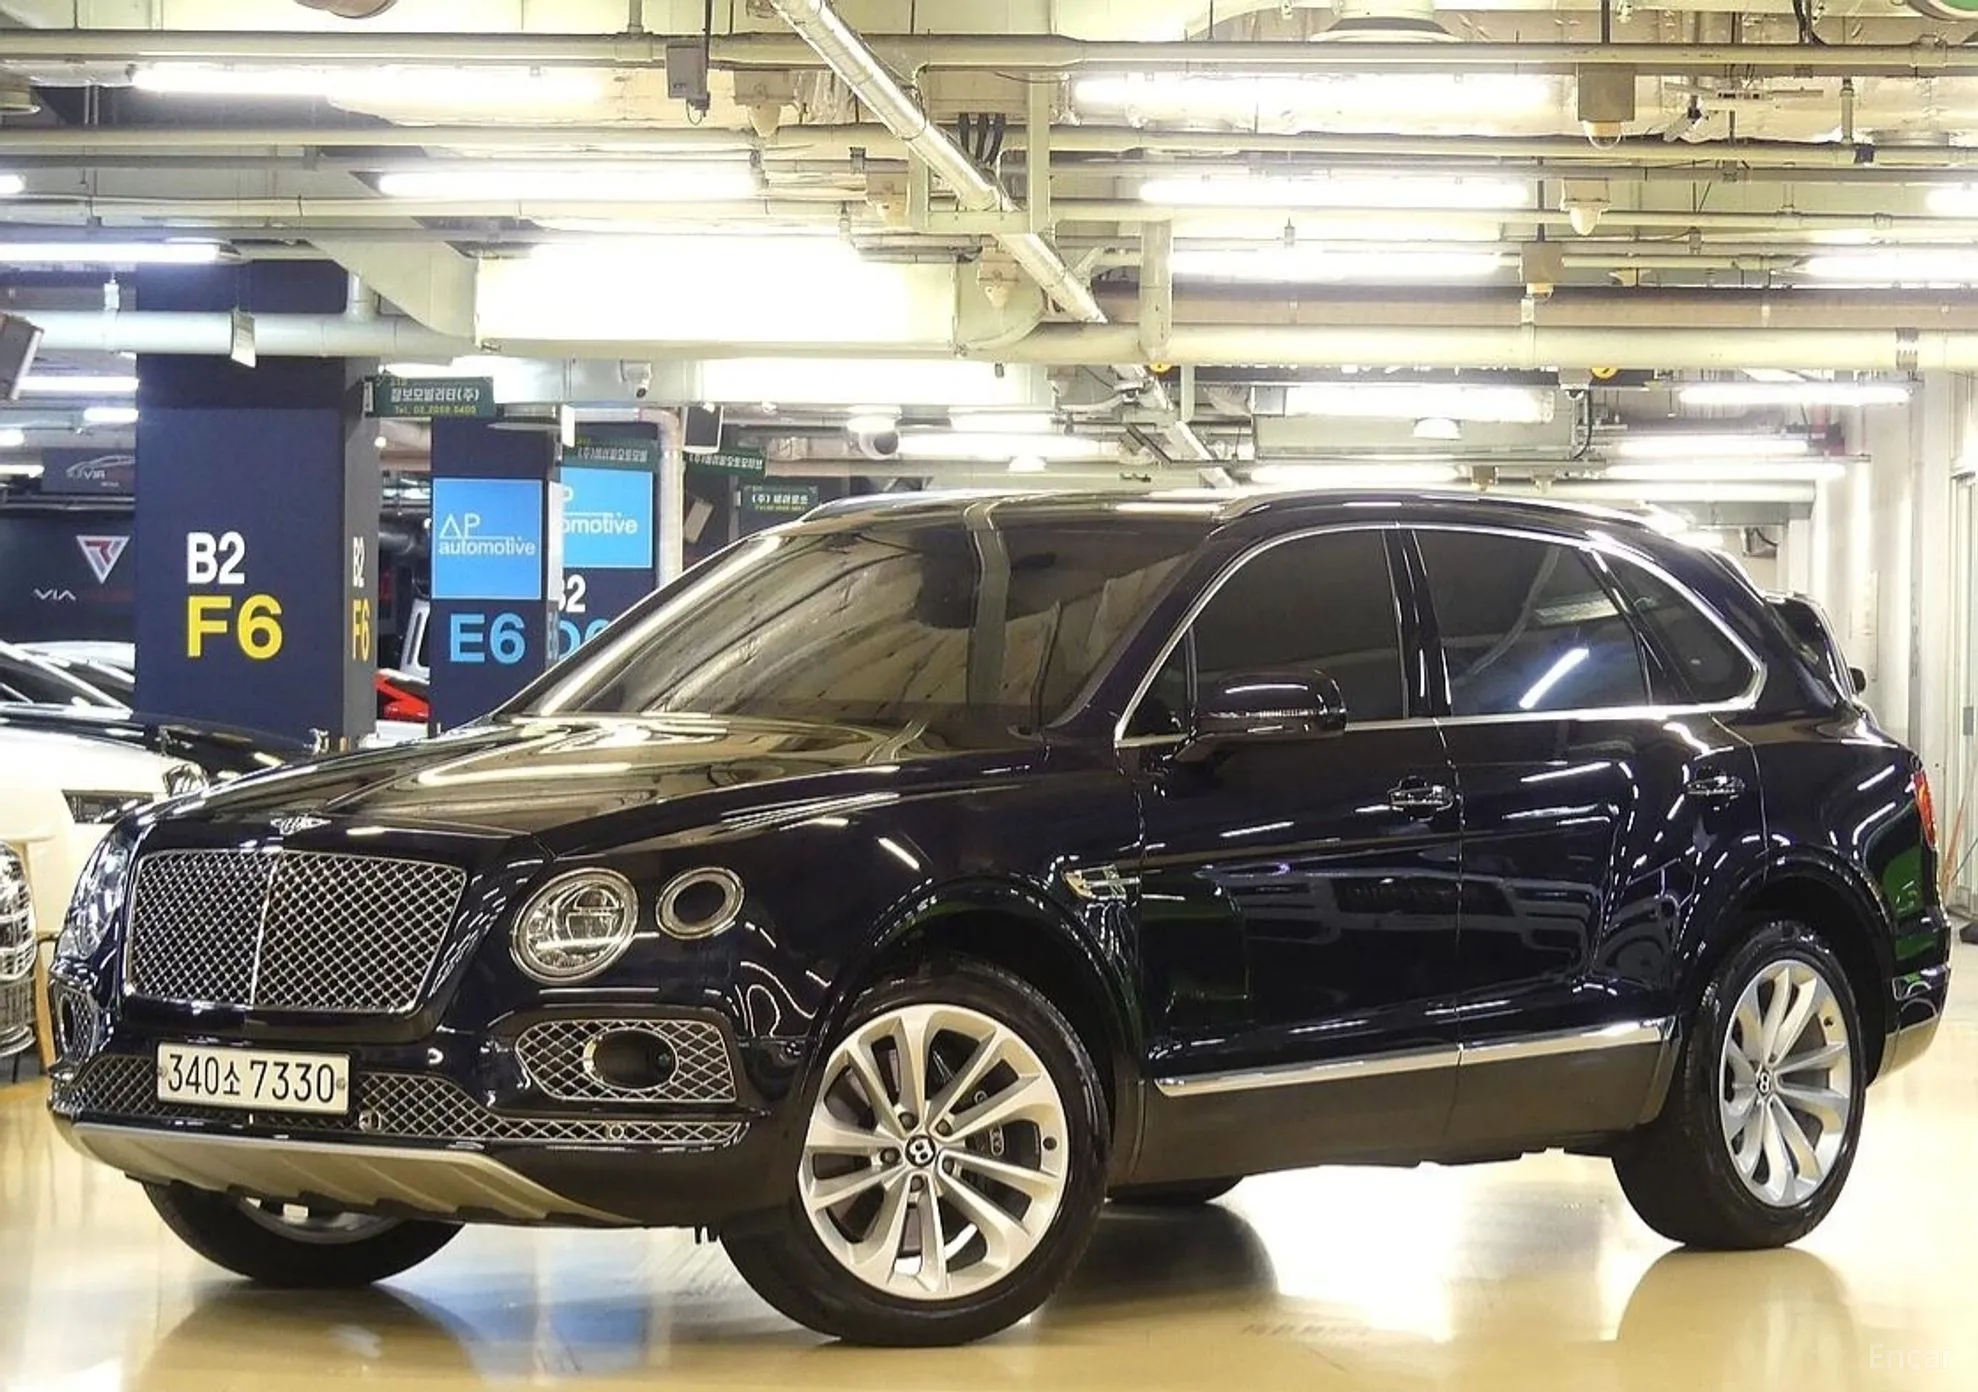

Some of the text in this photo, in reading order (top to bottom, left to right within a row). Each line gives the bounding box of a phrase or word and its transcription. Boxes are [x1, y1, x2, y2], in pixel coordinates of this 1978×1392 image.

[439, 512, 481, 539] AP
[439, 537, 536, 555] automotive
[187, 531, 246, 584] B2
[353, 536, 365, 588] B2
[188, 594, 282, 659] F6
[353, 598, 370, 661] F6
[450, 612, 526, 664] E6
[168, 1053, 335, 1104] 340소 7330
